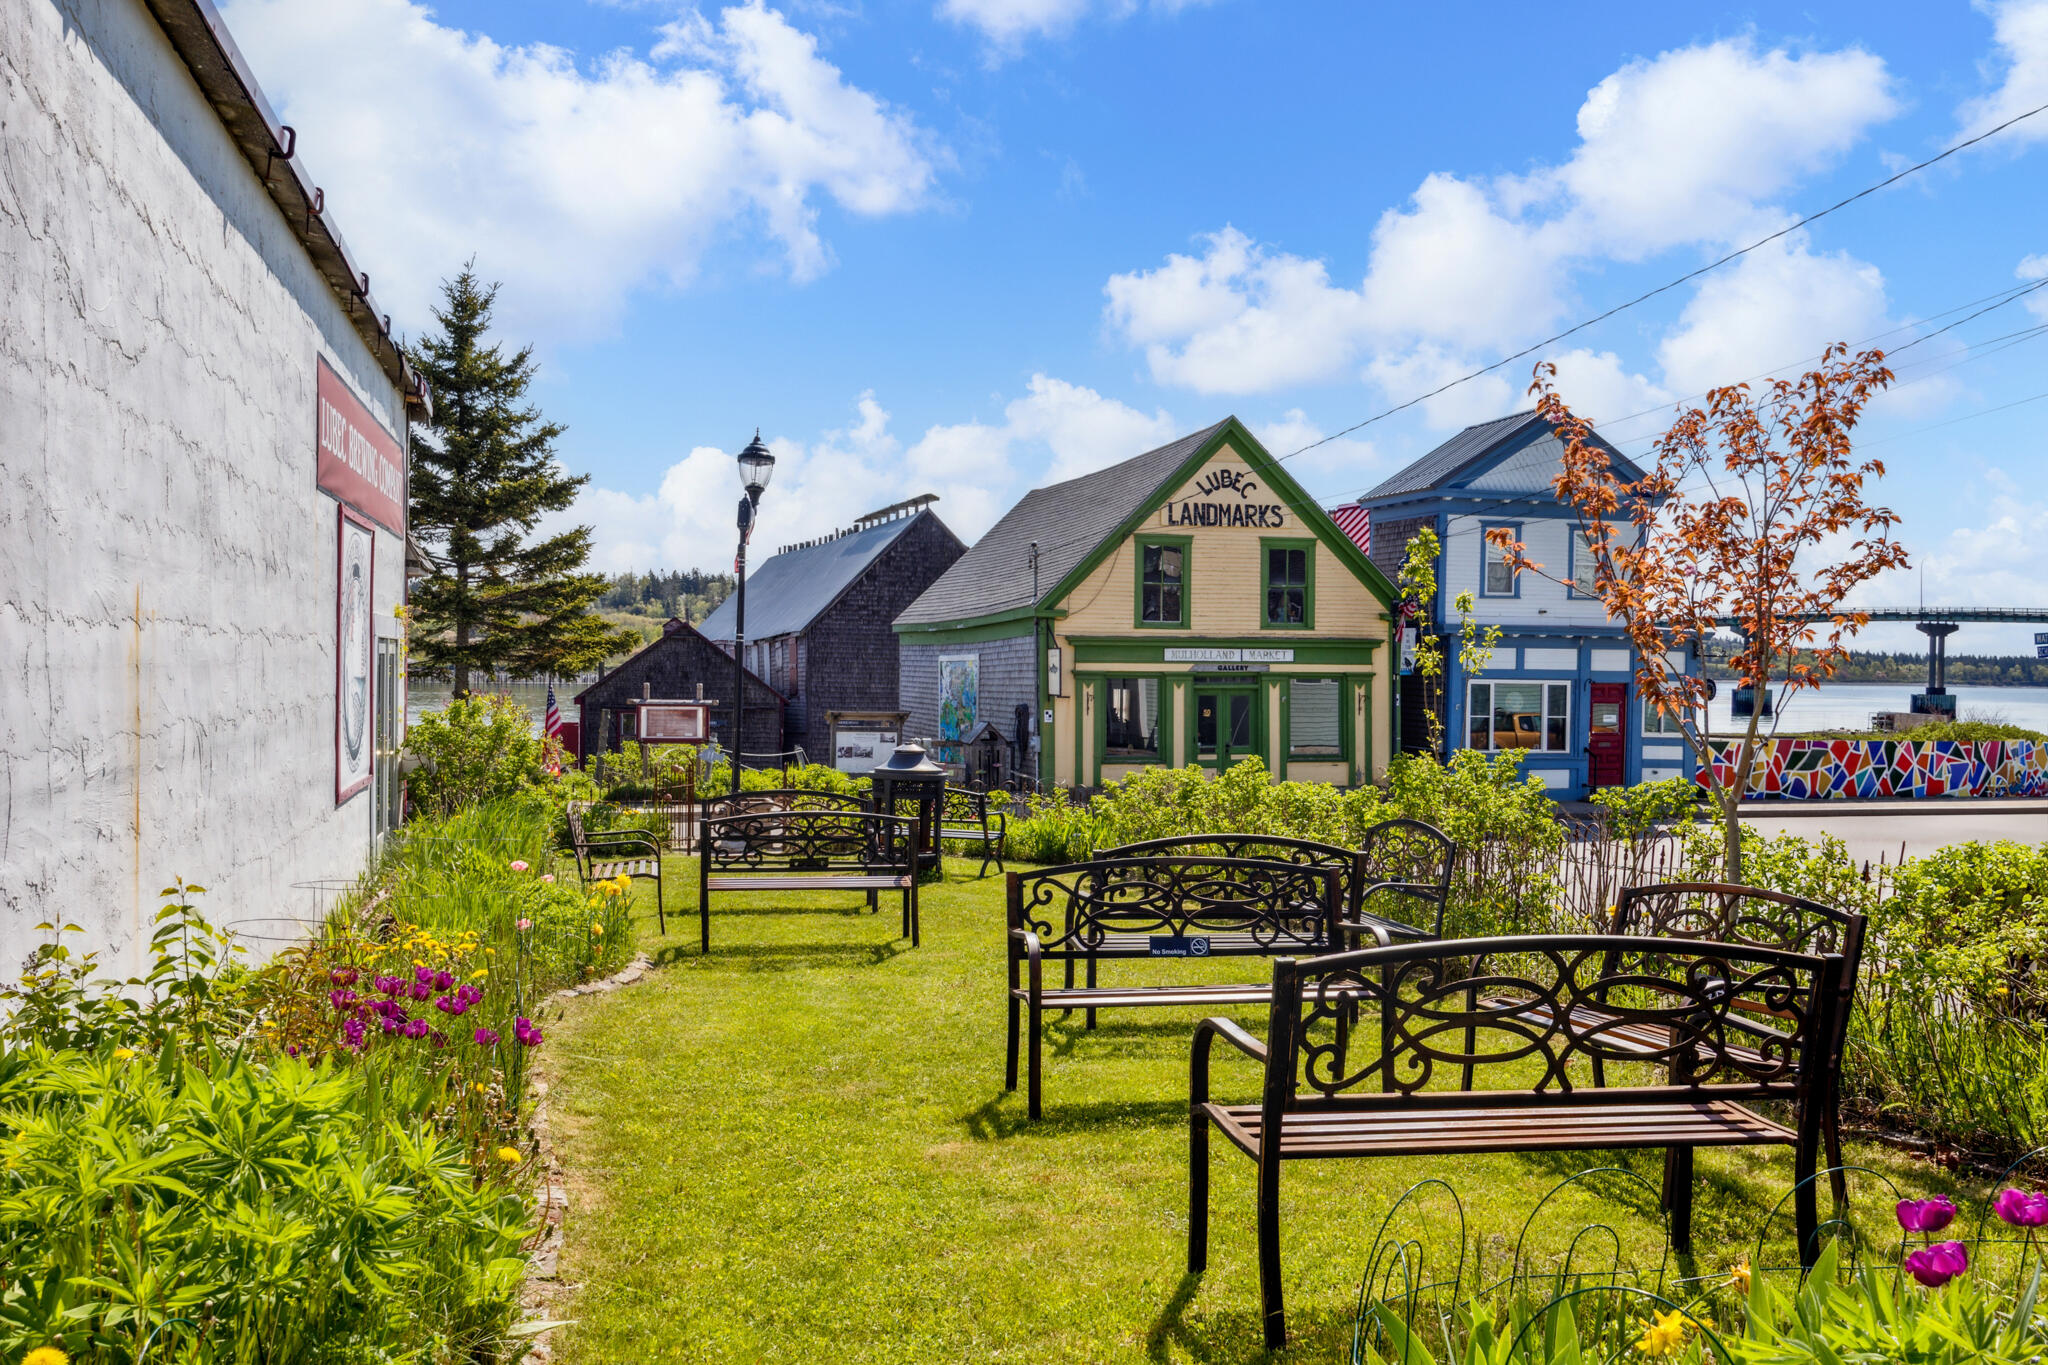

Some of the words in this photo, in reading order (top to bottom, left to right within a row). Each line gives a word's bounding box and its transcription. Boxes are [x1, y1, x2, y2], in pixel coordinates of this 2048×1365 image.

[321, 397, 347, 463] LUBEC
[348, 424, 379, 488] BREWING
[379, 454, 403, 506] COMPANY
[1195, 469, 1257, 499] LUBEC
[1168, 502, 1284, 528] LANDMARKS
[1171, 649, 1235, 660] MULHOLLAND
[1249, 650, 1287, 661] MARKET
[1217, 664, 1249, 672] GALLERY
